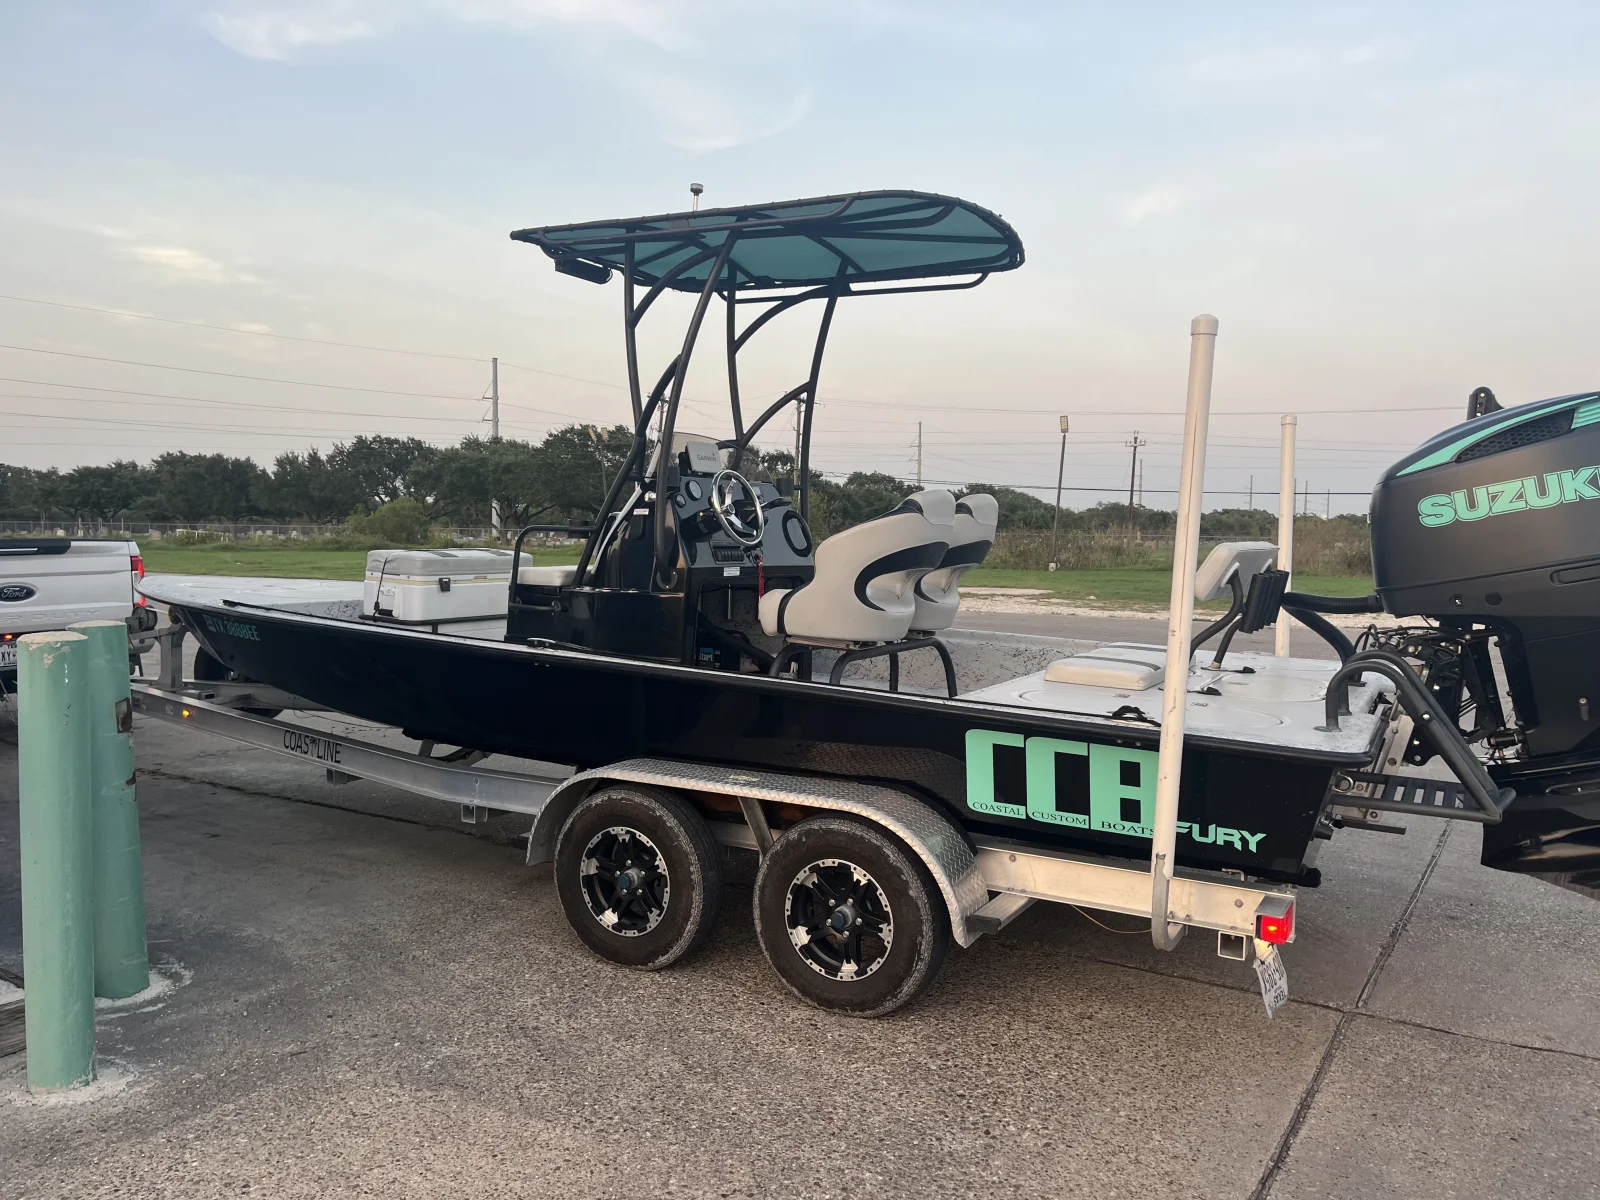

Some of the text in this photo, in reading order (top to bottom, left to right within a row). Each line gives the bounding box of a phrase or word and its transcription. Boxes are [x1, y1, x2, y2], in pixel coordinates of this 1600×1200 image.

[1418, 465, 1600, 528] SUZUK
[1, 587, 27, 598] Ford
[972, 801, 1024, 816] COASTAL
[1032, 811, 1088, 826] CUSTOM
